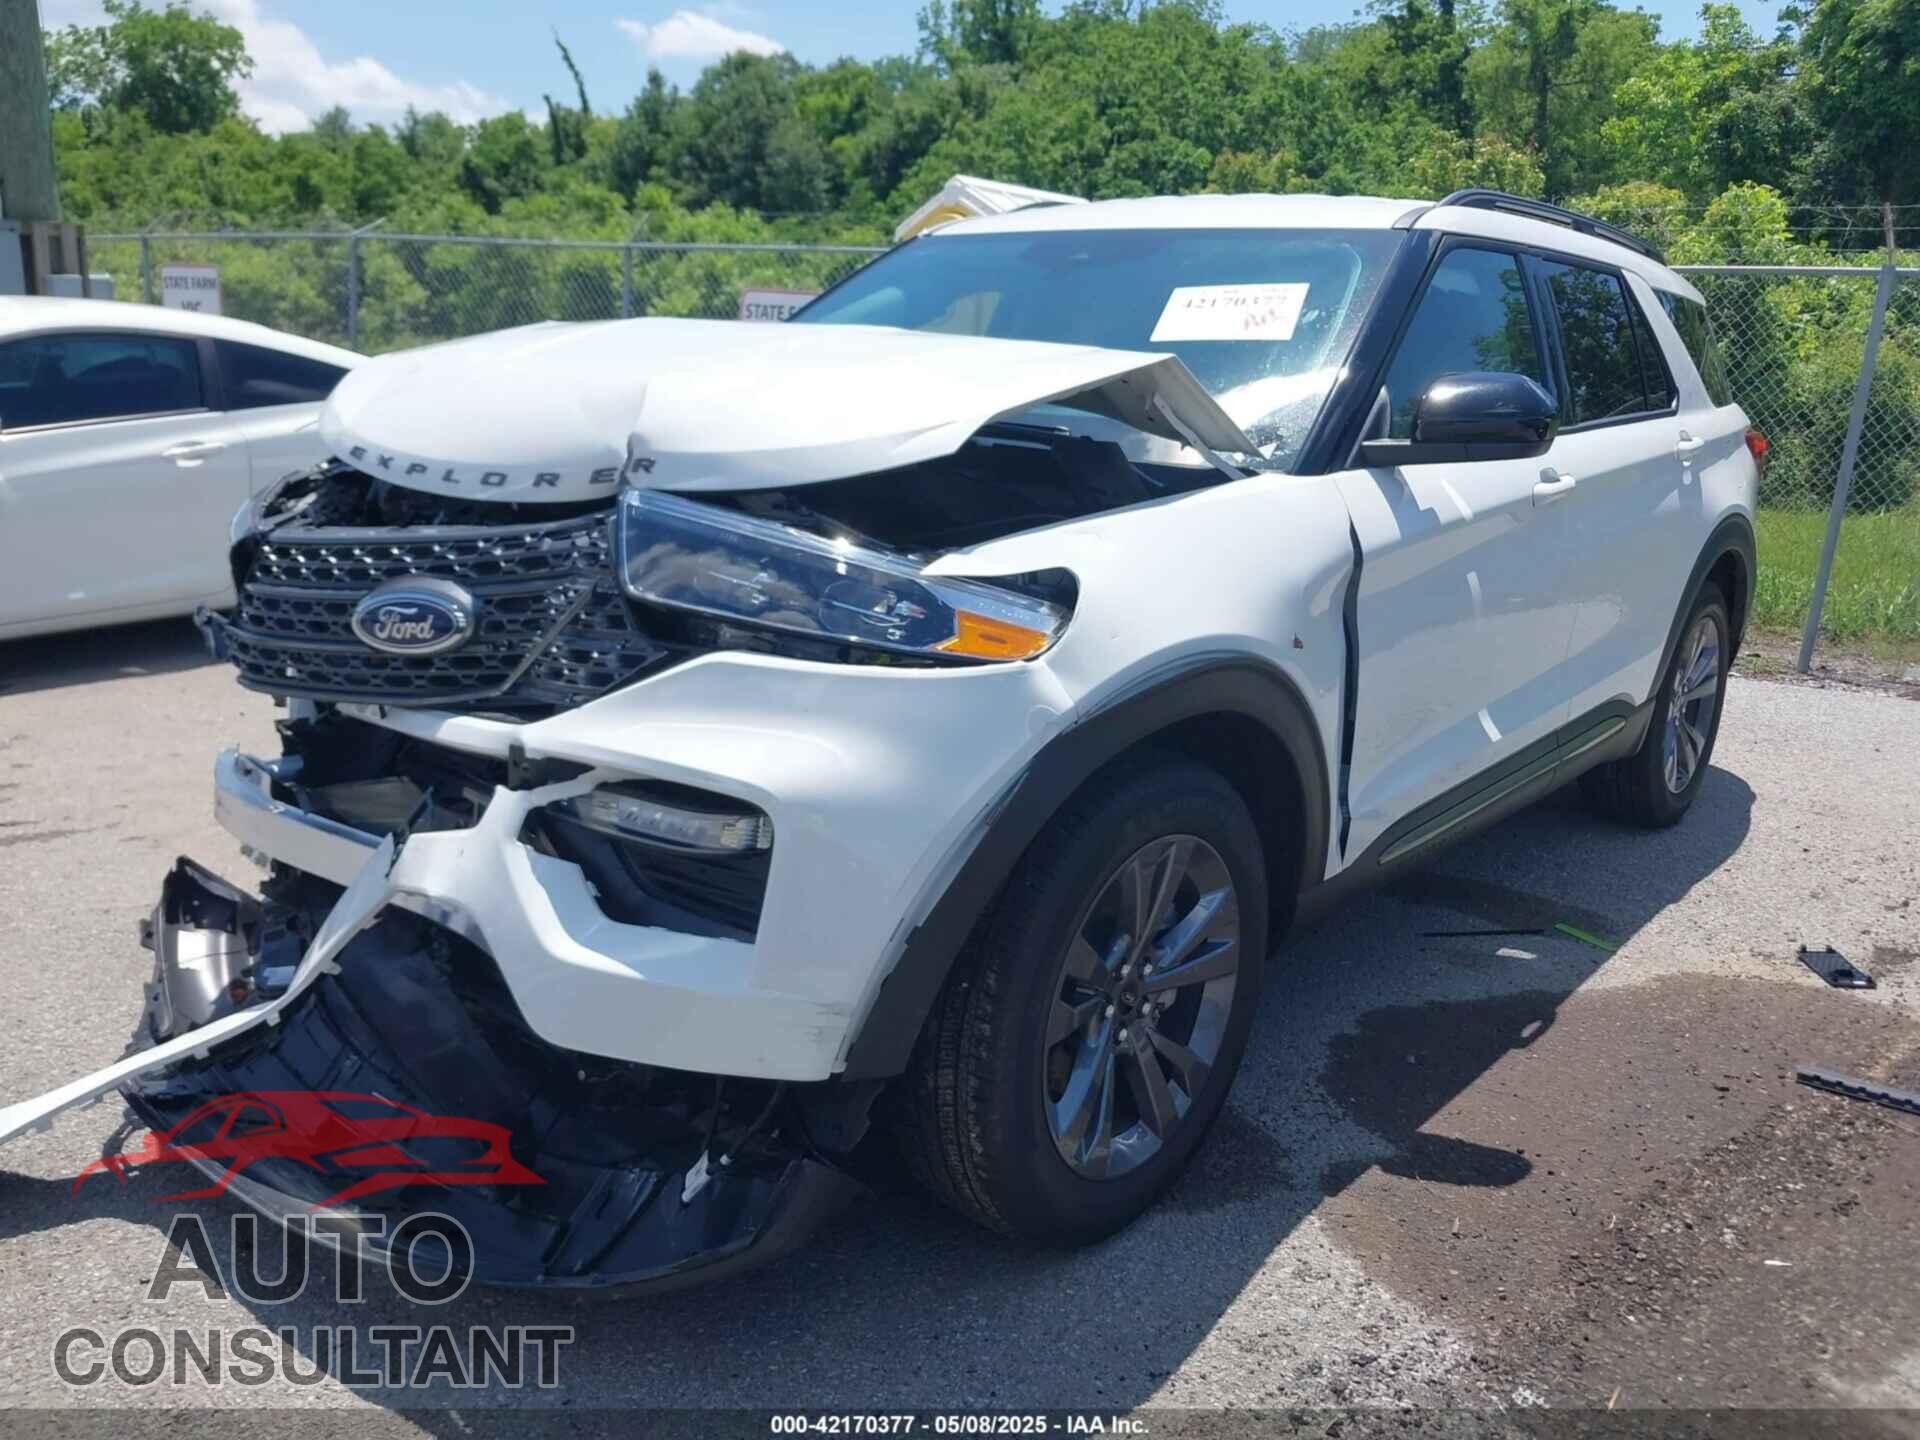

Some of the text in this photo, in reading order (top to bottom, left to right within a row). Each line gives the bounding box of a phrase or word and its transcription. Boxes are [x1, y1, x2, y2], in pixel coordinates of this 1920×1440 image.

[164, 276, 217, 289] STATE FARM
[745, 303, 785, 320] STATE
[349, 445, 656, 488] EXPLORER
[373, 605, 435, 640] Ford
